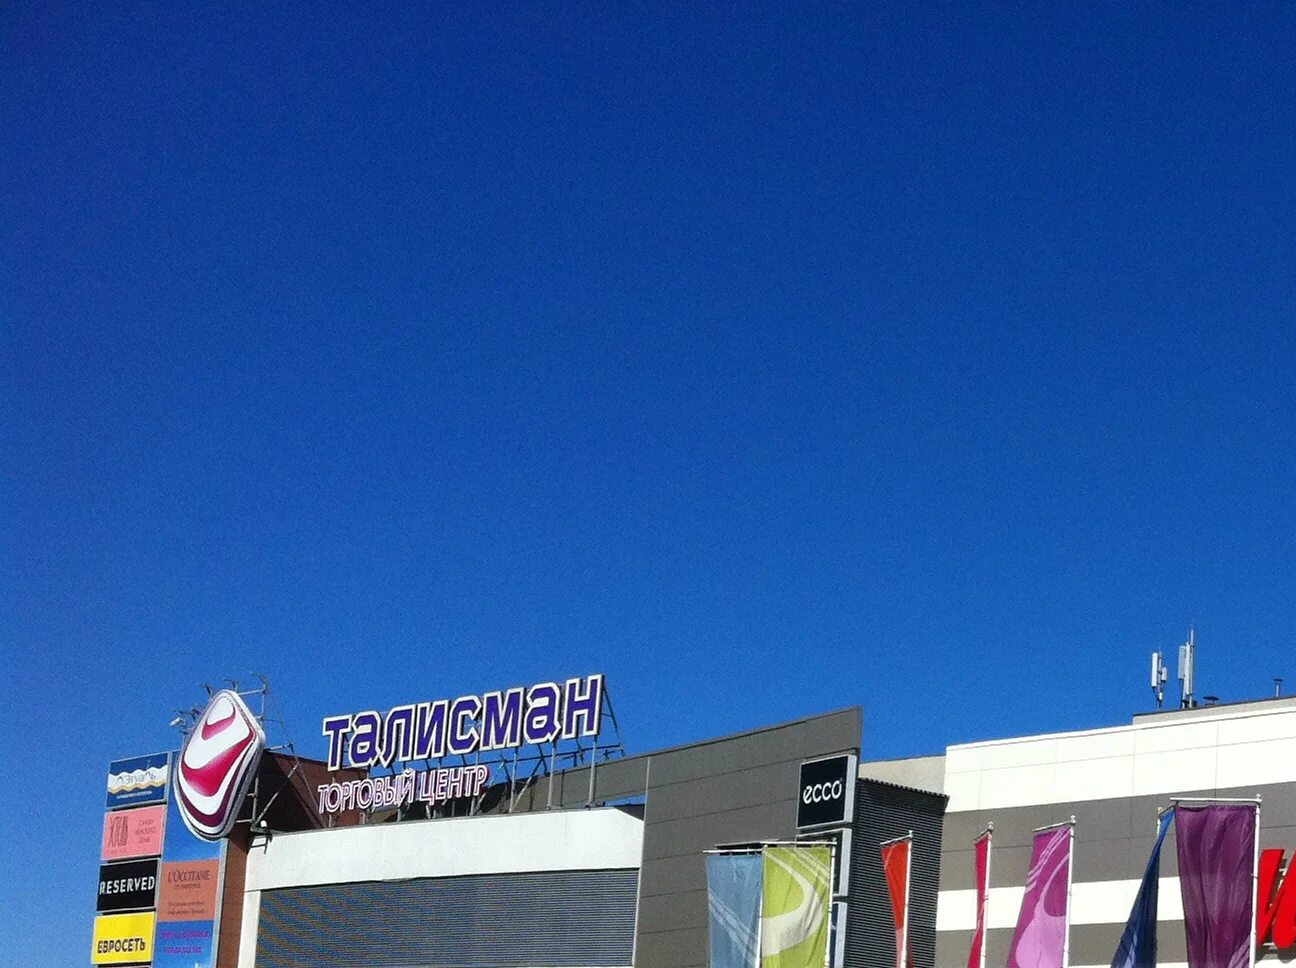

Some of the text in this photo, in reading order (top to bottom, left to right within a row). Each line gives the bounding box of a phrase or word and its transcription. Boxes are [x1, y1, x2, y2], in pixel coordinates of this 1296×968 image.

[317, 764, 488, 814] ТОРГОВЫЙ ЦЕНТР
[803, 780, 842, 804] ecco
[99, 876, 156, 895] RESERVED
[97, 938, 146, 954] ЕВРОСЕТЬ
